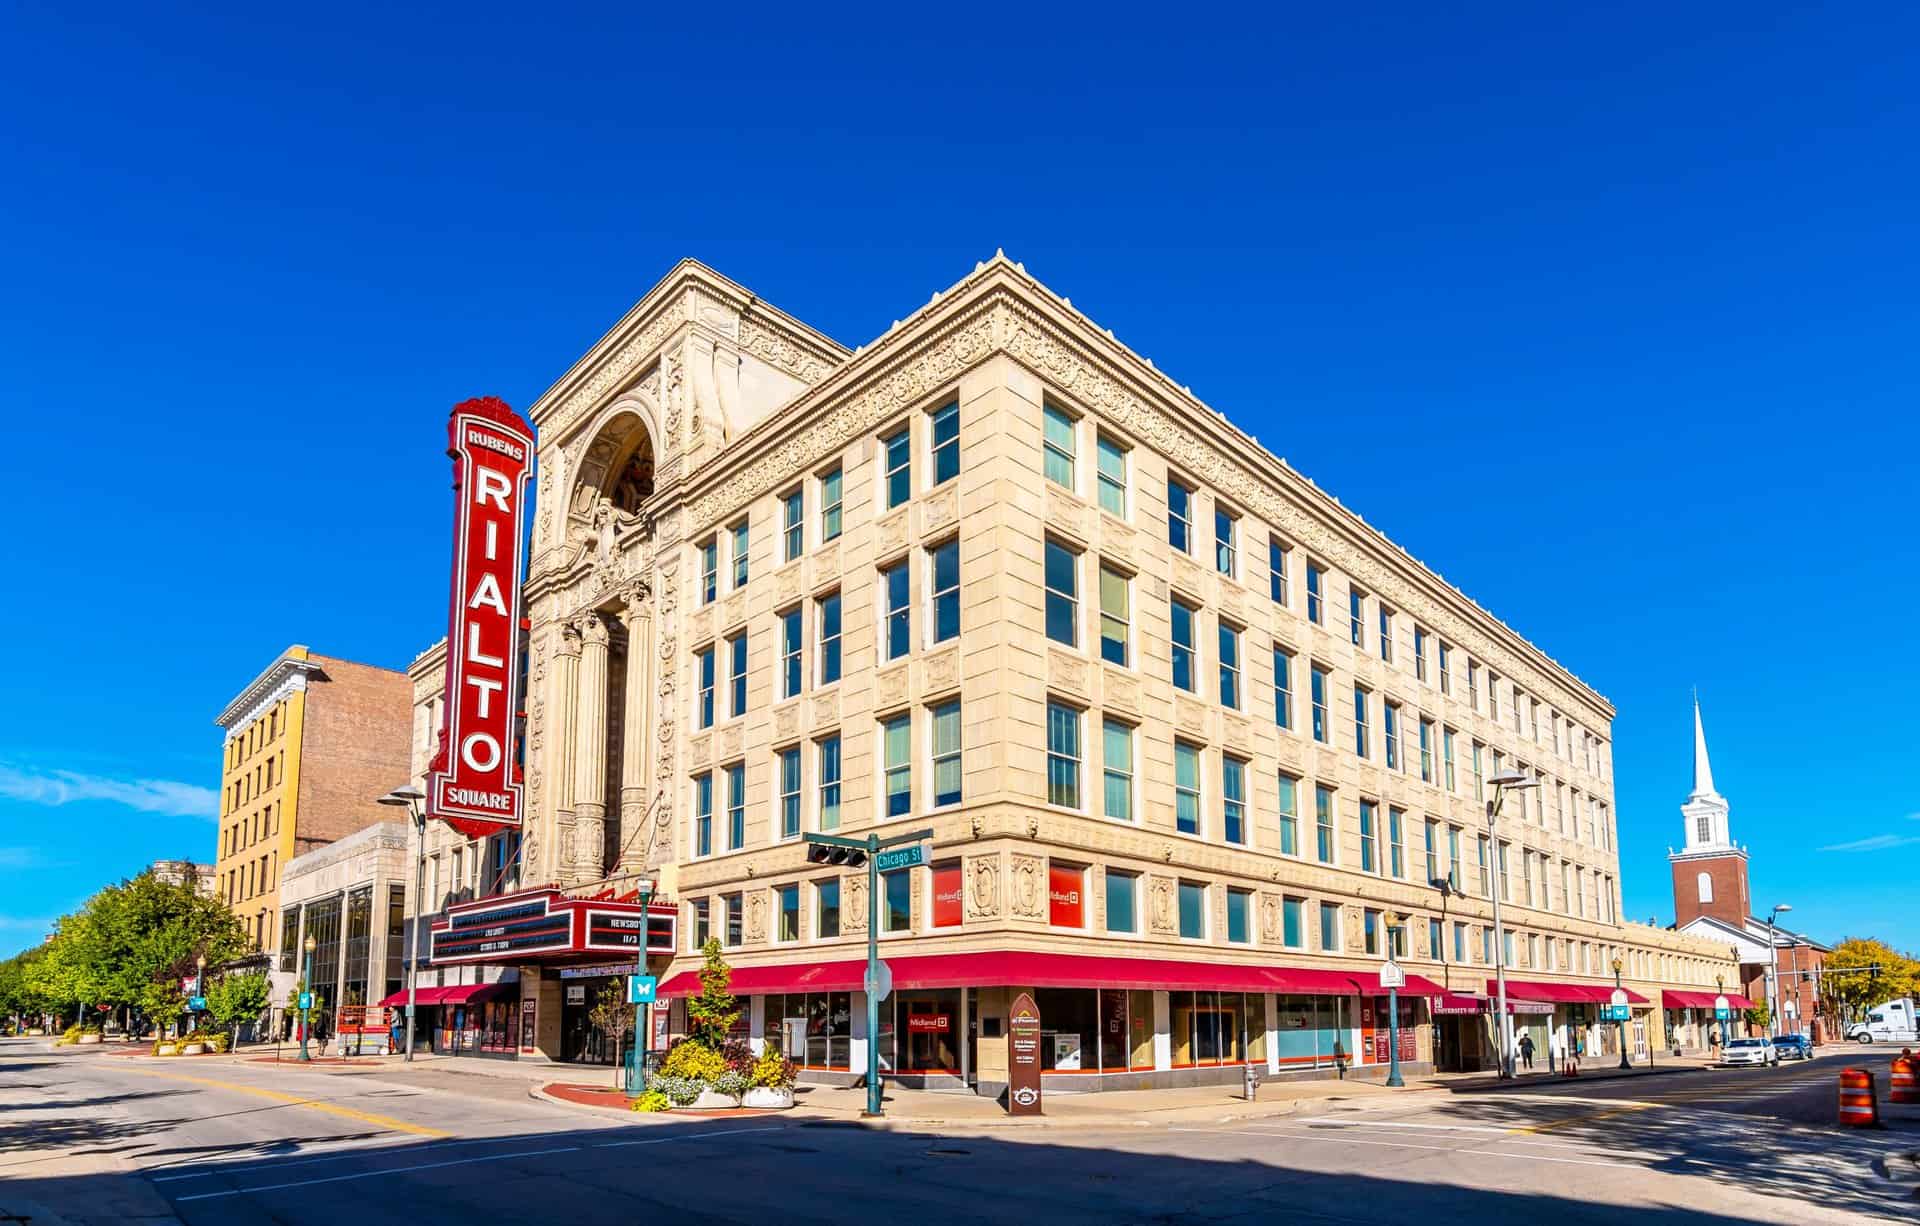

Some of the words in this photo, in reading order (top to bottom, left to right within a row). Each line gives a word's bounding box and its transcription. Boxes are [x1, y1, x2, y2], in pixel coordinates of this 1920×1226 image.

[468, 430, 523, 460] RUBENS
[461, 464, 513, 773] RIALTO
[447, 787, 511, 810] SQUARE
[878, 851, 909, 867] Chicago
[911, 847, 921, 861] St
[910, 1017, 937, 1026] Midland
